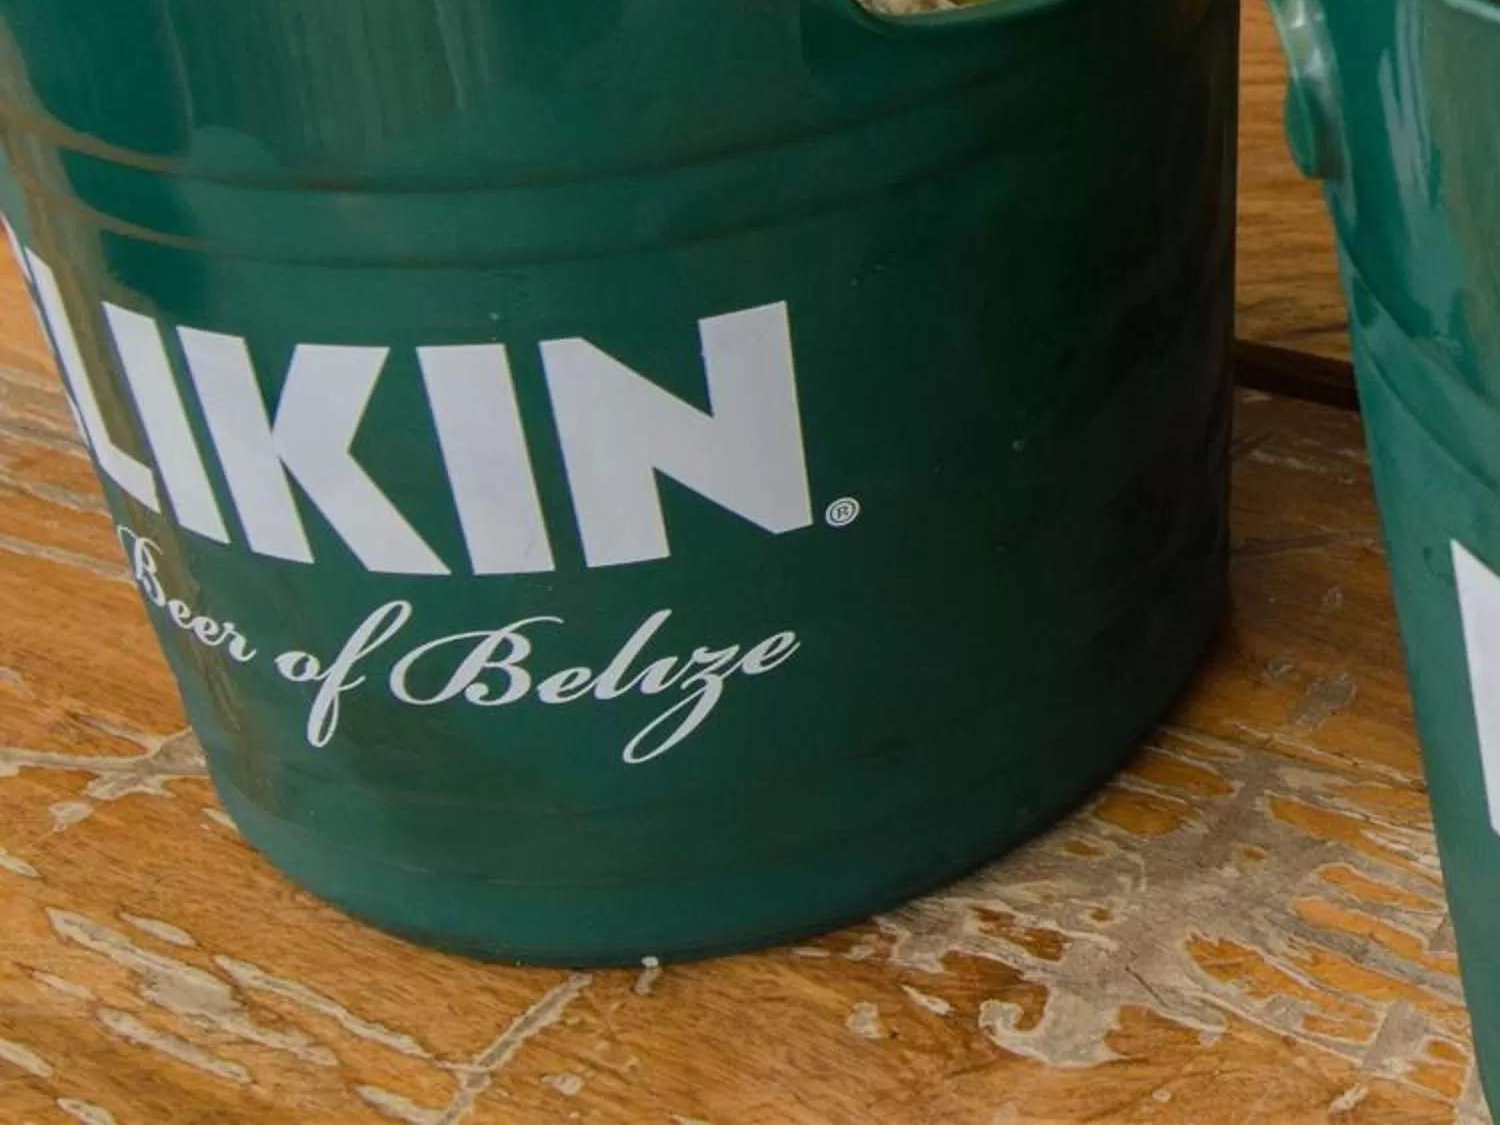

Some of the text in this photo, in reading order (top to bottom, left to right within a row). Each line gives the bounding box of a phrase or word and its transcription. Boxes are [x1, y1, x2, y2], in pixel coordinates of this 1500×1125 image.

[1, 213, 813, 576] LIKIN
[117, 524, 801, 765] Beer of Belize
